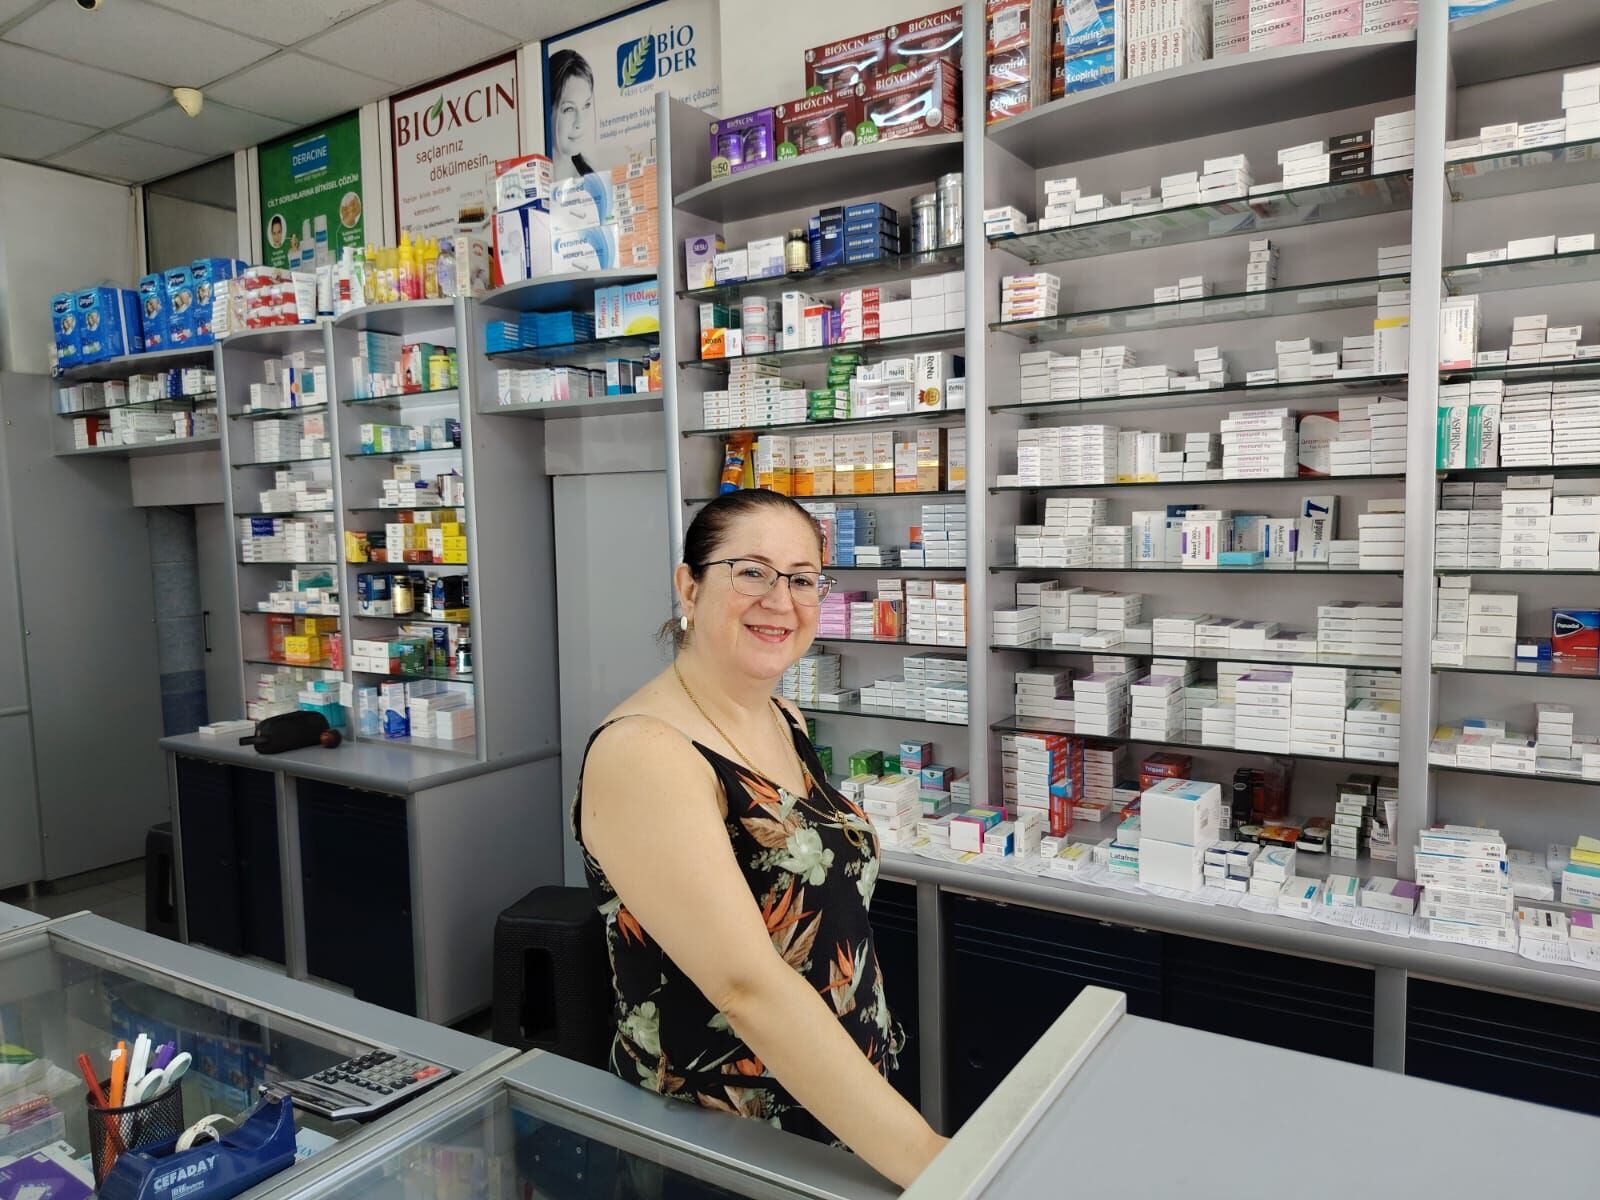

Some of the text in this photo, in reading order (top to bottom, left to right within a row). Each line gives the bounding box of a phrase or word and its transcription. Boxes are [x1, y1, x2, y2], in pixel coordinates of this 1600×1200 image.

[908, 13, 952, 33] BIOXCIN
[1215, 14, 1249, 27] DOLORE
[1307, 8, 1349, 22] DOLOREX
[1250, 22, 1291, 36] DOLOREX
[824, 38, 865, 57] BIOXCIN
[1215, 36, 1249, 49] DOLORE
[658, 47, 697, 78] DER
[875, 70, 918, 90] BIOXCIN
[396, 77, 516, 147] BIOXCIN
[794, 94, 833, 113] BIOXCIN
[927, 355, 935, 380] ReNu
[153, 1155, 217, 1191] CEFADAY
